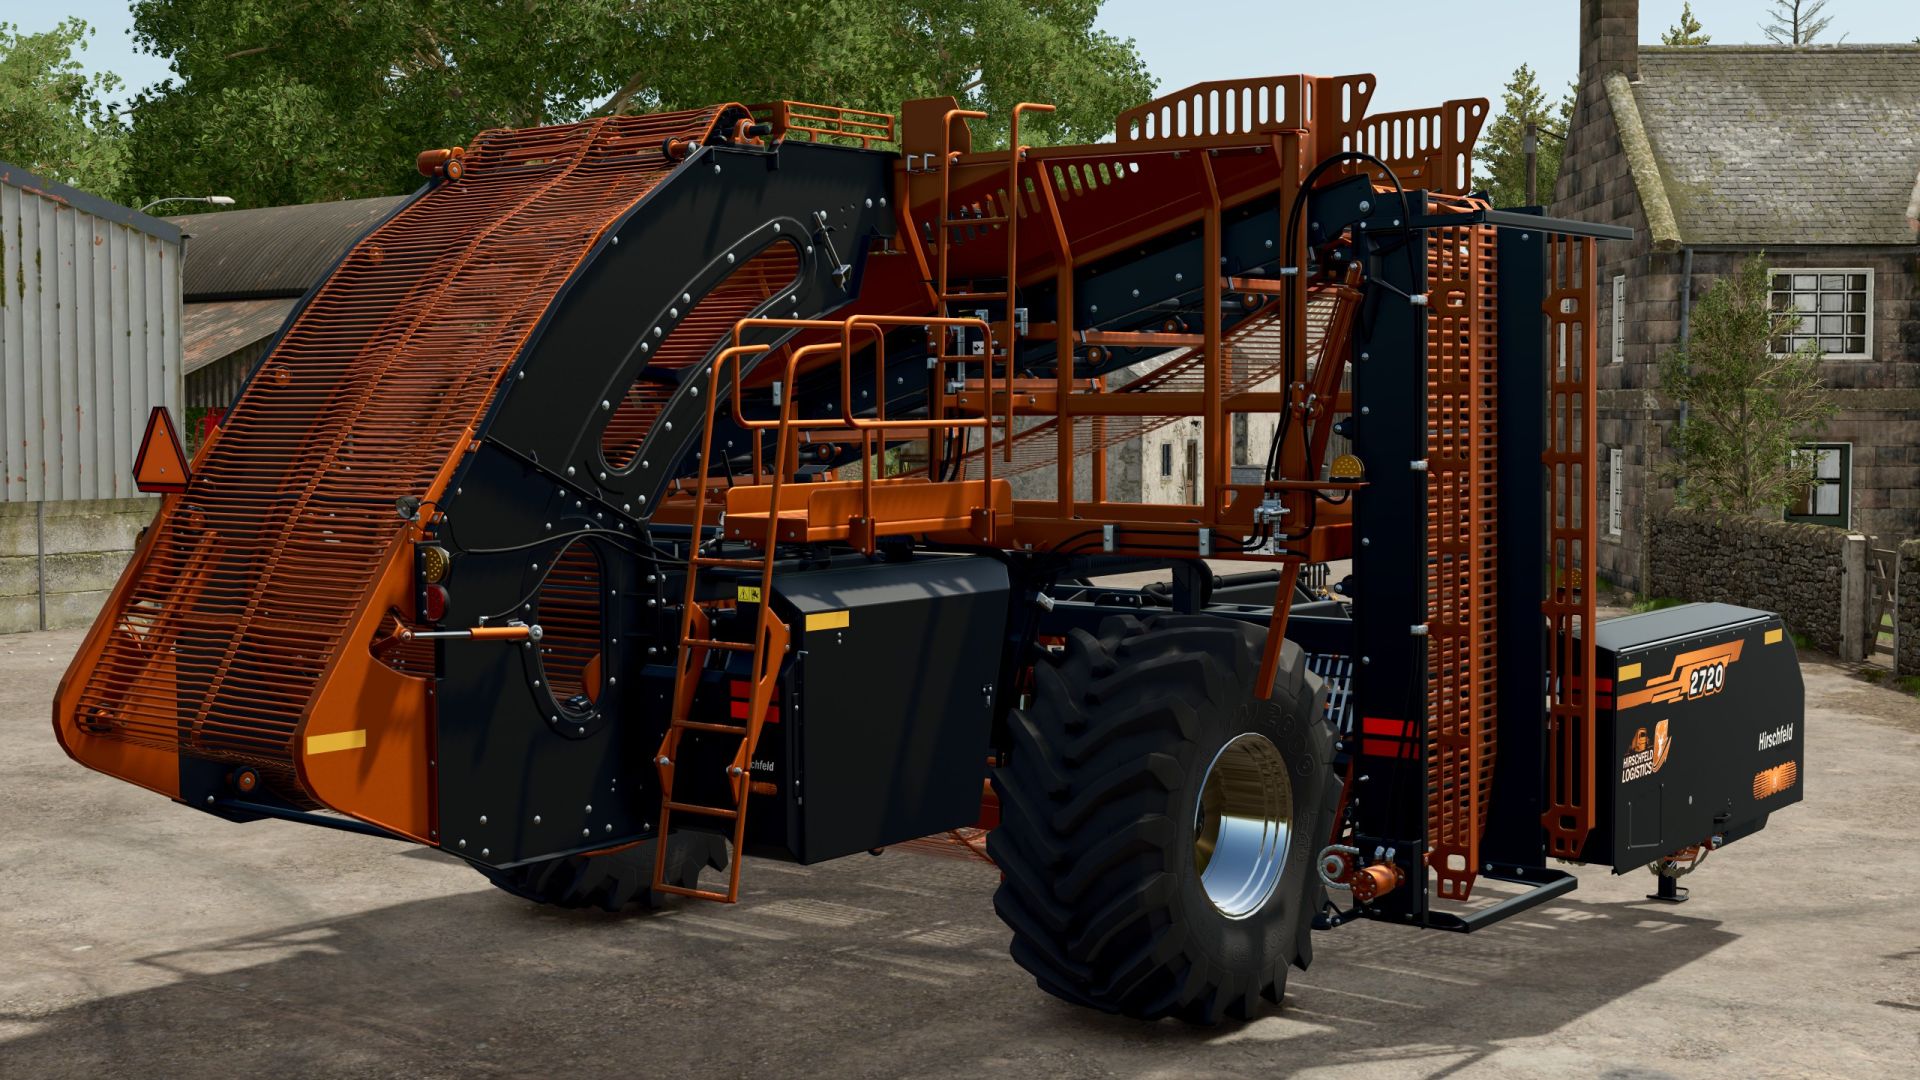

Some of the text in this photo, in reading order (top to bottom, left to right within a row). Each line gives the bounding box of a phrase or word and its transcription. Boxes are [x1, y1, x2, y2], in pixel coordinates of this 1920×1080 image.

[1689, 663, 1724, 696] 2720
[1758, 722, 1794, 751] Hirschfeld
[750, 760, 774, 772] chfeld
[1623, 749, 1654, 769] HIRSCHFELD
[1622, 761, 1653, 784] LOGISTICS
